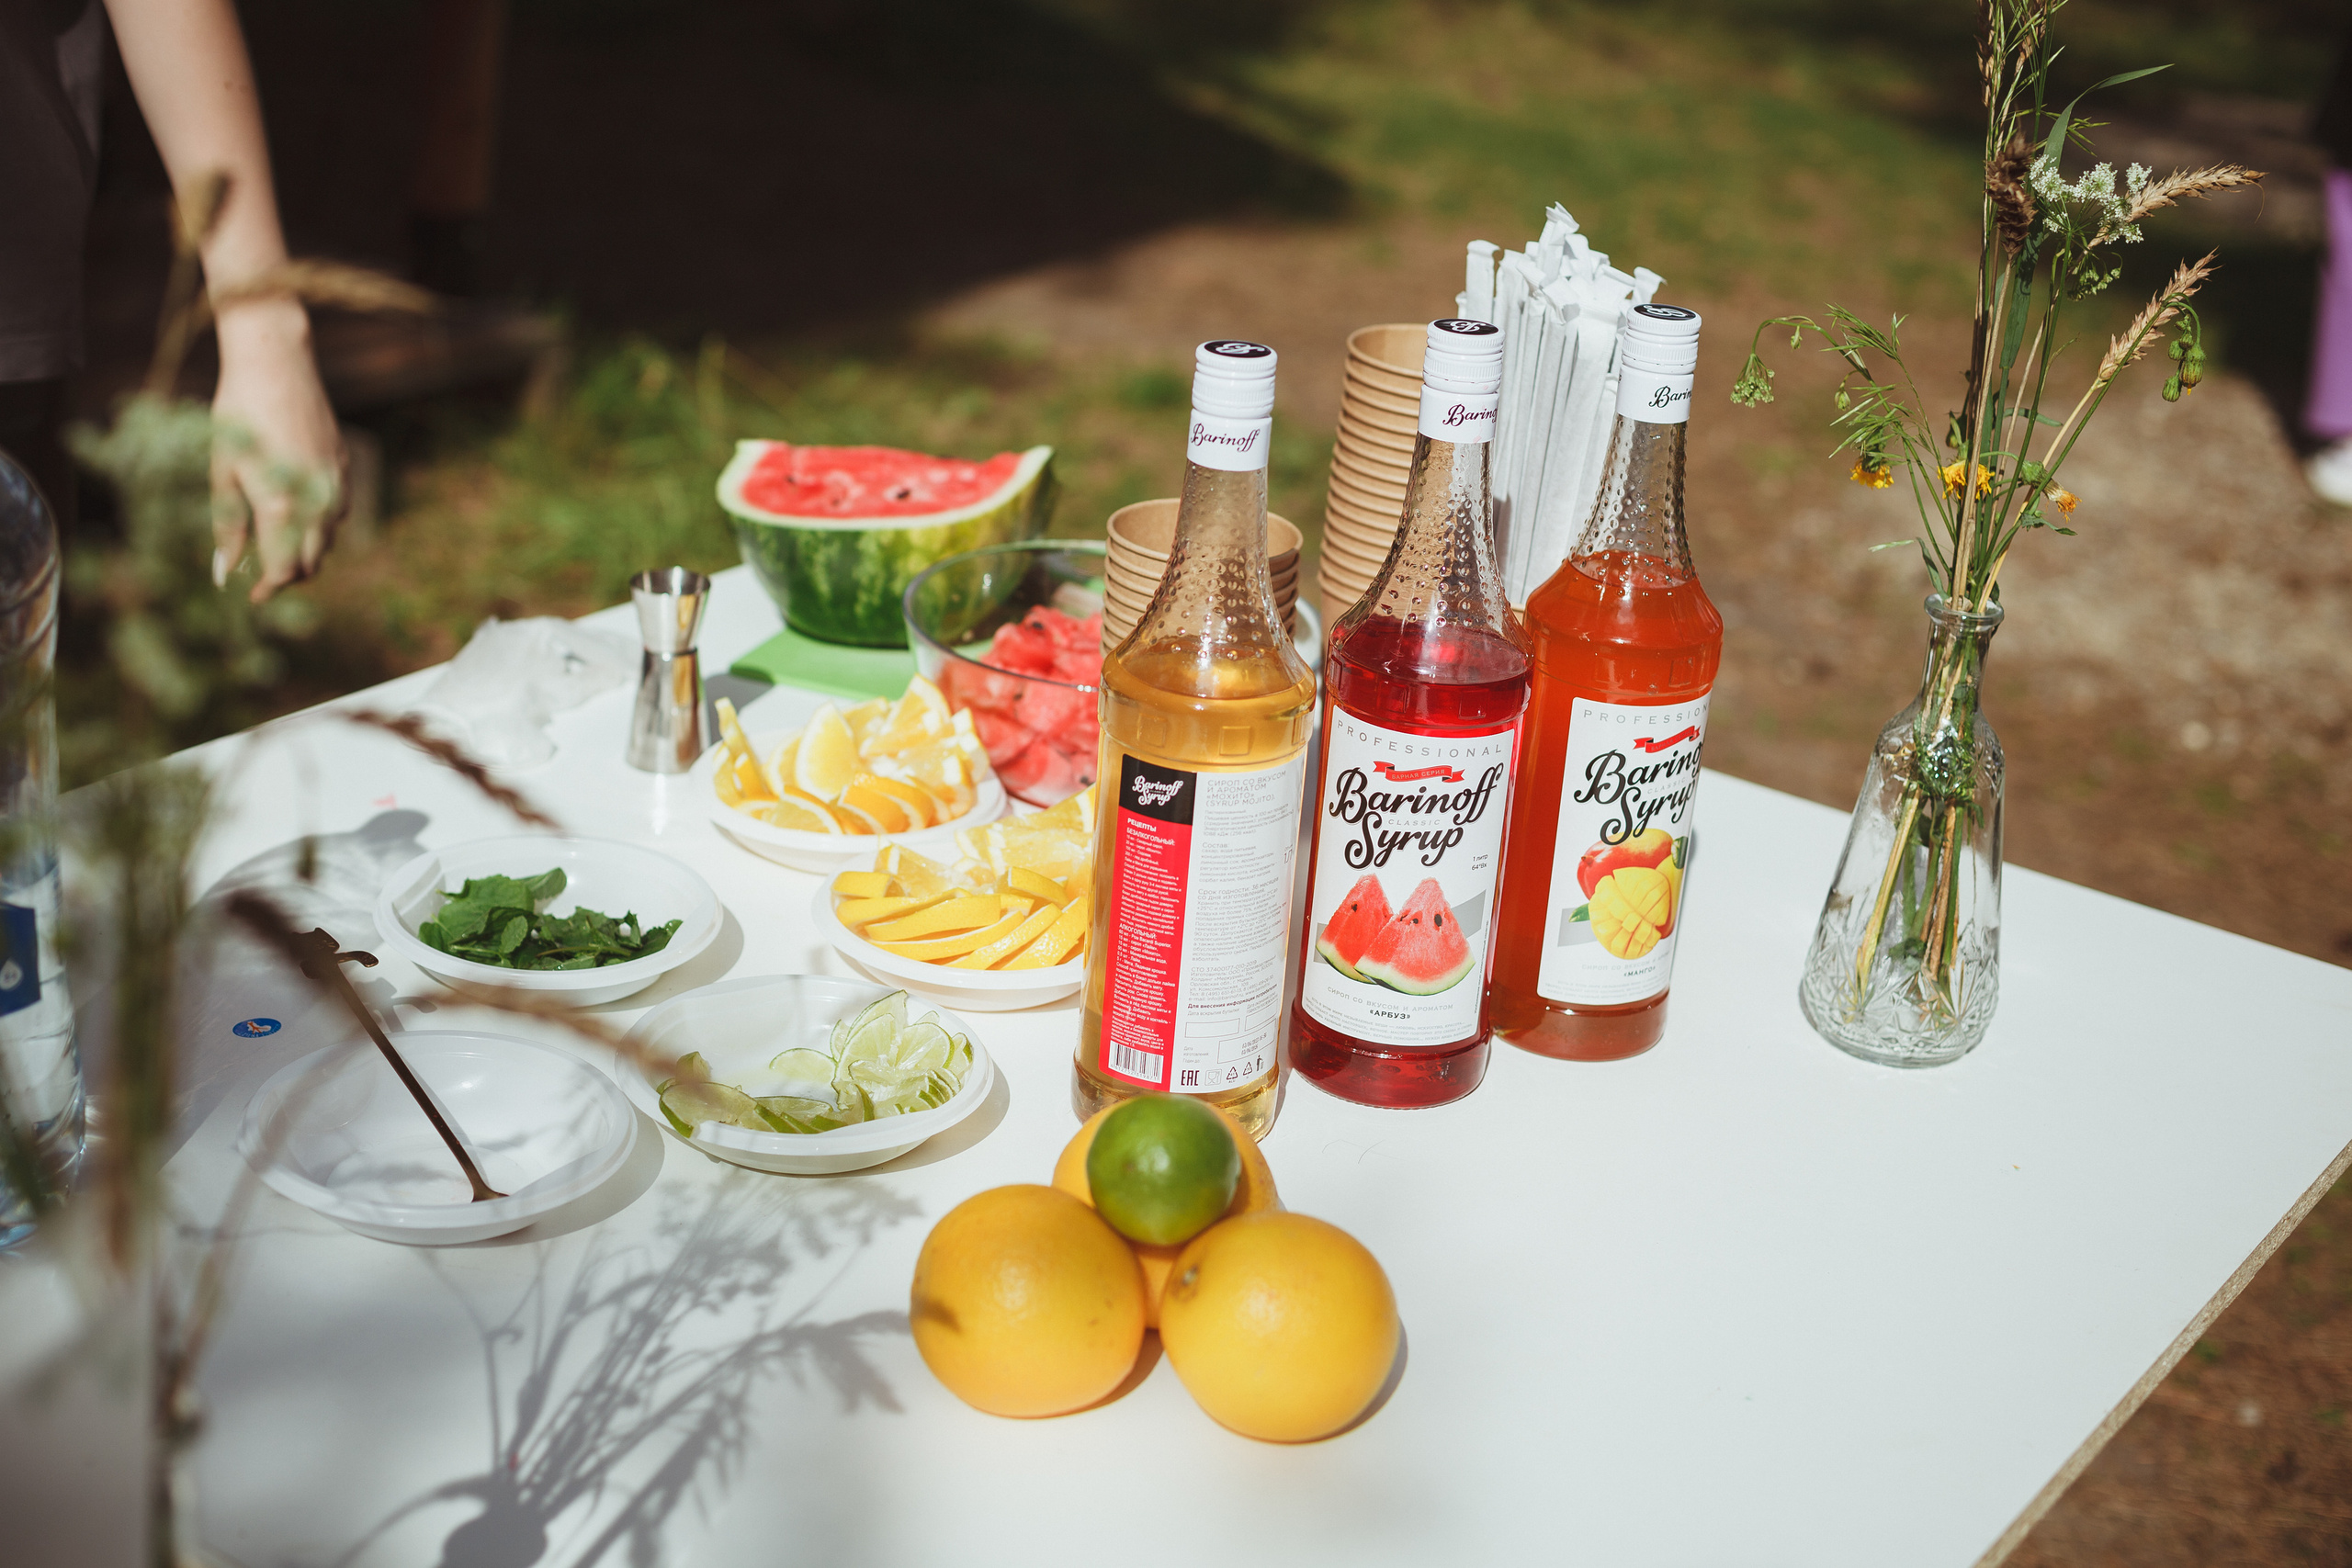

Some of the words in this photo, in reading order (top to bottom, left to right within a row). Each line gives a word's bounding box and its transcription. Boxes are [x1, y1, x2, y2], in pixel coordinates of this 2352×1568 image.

[1190, 423, 1261, 453] Barinoff
[1337, 719, 1502, 759] PROFESSIONAL
[1207, 779, 1239, 787] СИРОП
[1257, 770, 1286, 783] ВКУСОМ
[1391, 773, 1420, 781] БАРНАЯ
[1420, 769, 1446, 777] СЕРИЯ
[1131, 774, 1184, 796] Barinoff
[1216, 783, 1267, 794] АРОМАТОМ
[1329, 762, 1505, 825] Barinoff
[1137, 787, 1171, 807] Syrup
[1205, 799, 1239, 807] (SYRUP
[1206, 792, 1255, 800] «МОХИТО»
[1600, 779, 1696, 845] Syrup
[1127, 818, 1157, 832] РЕЦЕПТЫ
[1387, 818, 1442, 827] CLASSIC
[1126, 827, 1175, 846] БЕЗАЛКОГОЛЬНЫЙ:
[1344, 811, 1464, 870] Syrup
[1119, 923, 1157, 939] АЛКОГОЛЬНЫЙ:
[1623, 965, 1656, 976] «МАНГО»
[1327, 986, 1350, 999] СИРОП
[1352, 996, 1363, 1004] СО
[1366, 1000, 1399, 1010] ВКУСОМ
[1369, 1010, 1411, 1021] «АРБУЗ»
[1181, 1069, 1200, 1086] EAC
